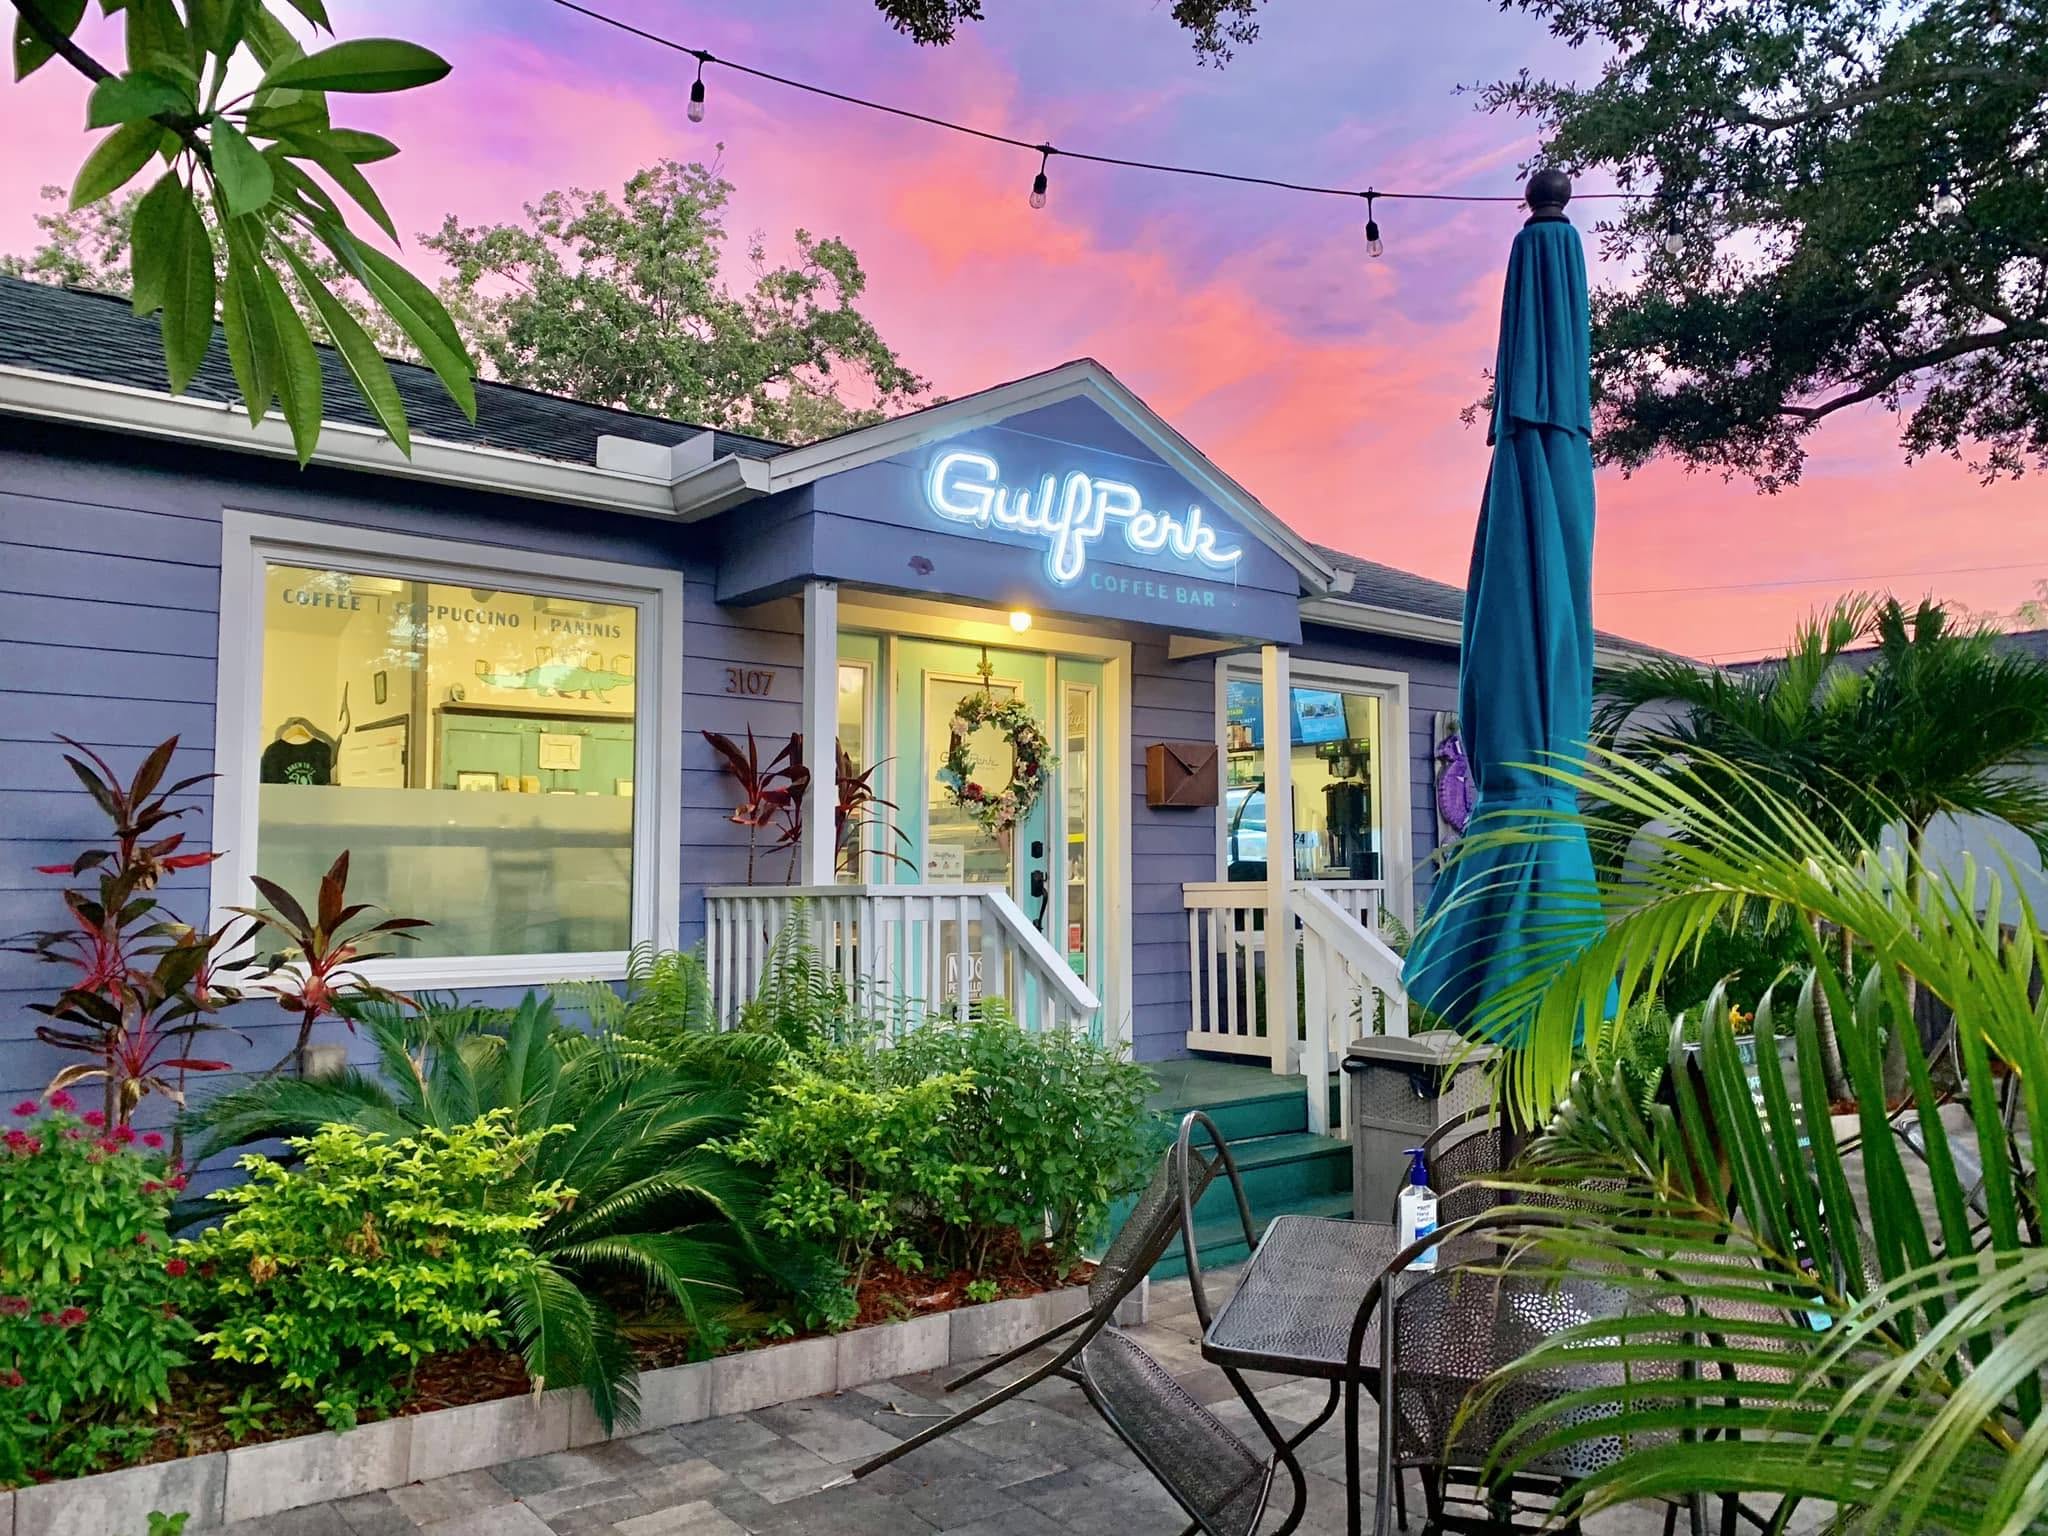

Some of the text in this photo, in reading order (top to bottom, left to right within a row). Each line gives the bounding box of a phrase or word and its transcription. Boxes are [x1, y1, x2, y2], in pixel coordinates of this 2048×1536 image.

[1090, 572, 1216, 607] COFFEE BAR
[282, 588, 622, 639] COFFEE CPPUCCINO PANINIS
[725, 666, 777, 697] 3107
